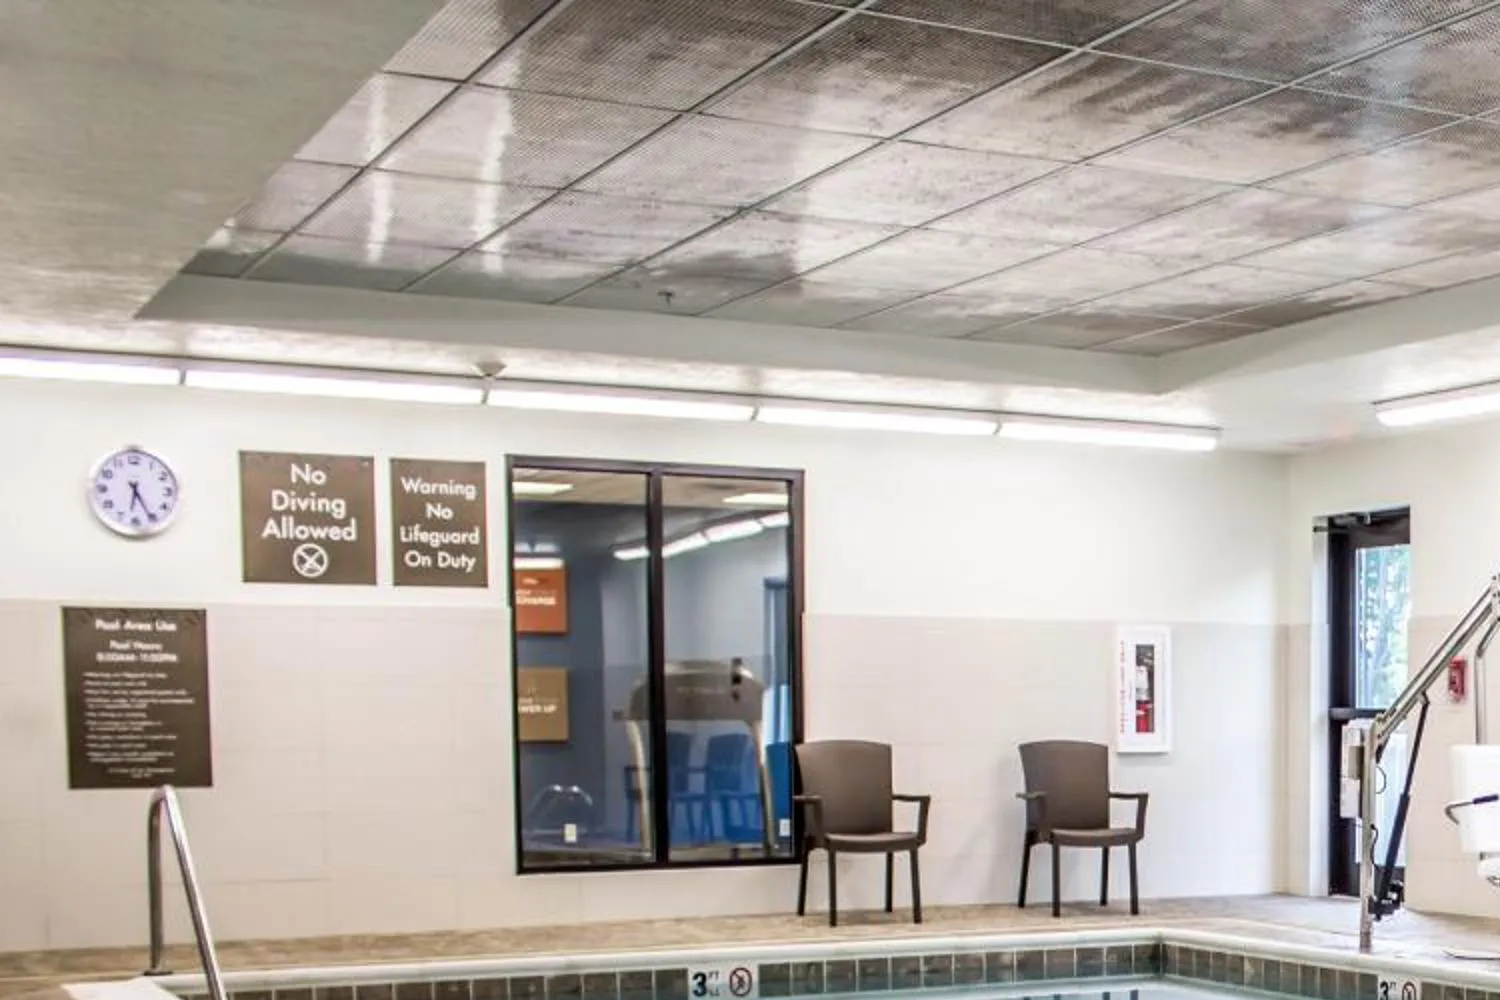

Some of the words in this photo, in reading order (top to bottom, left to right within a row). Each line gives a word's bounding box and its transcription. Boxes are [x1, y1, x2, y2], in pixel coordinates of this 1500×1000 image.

[290, 463, 327, 485] No
[401, 476, 477, 501] Warning
[271, 489, 347, 518] Diving
[425, 502, 454, 521] No
[261, 515, 357, 541] Allowed
[399, 524, 481, 548] Lifeguard
[404, 550, 432, 568] On
[437, 551, 477, 573] Duty
[692, 971, 707, 998] 3
